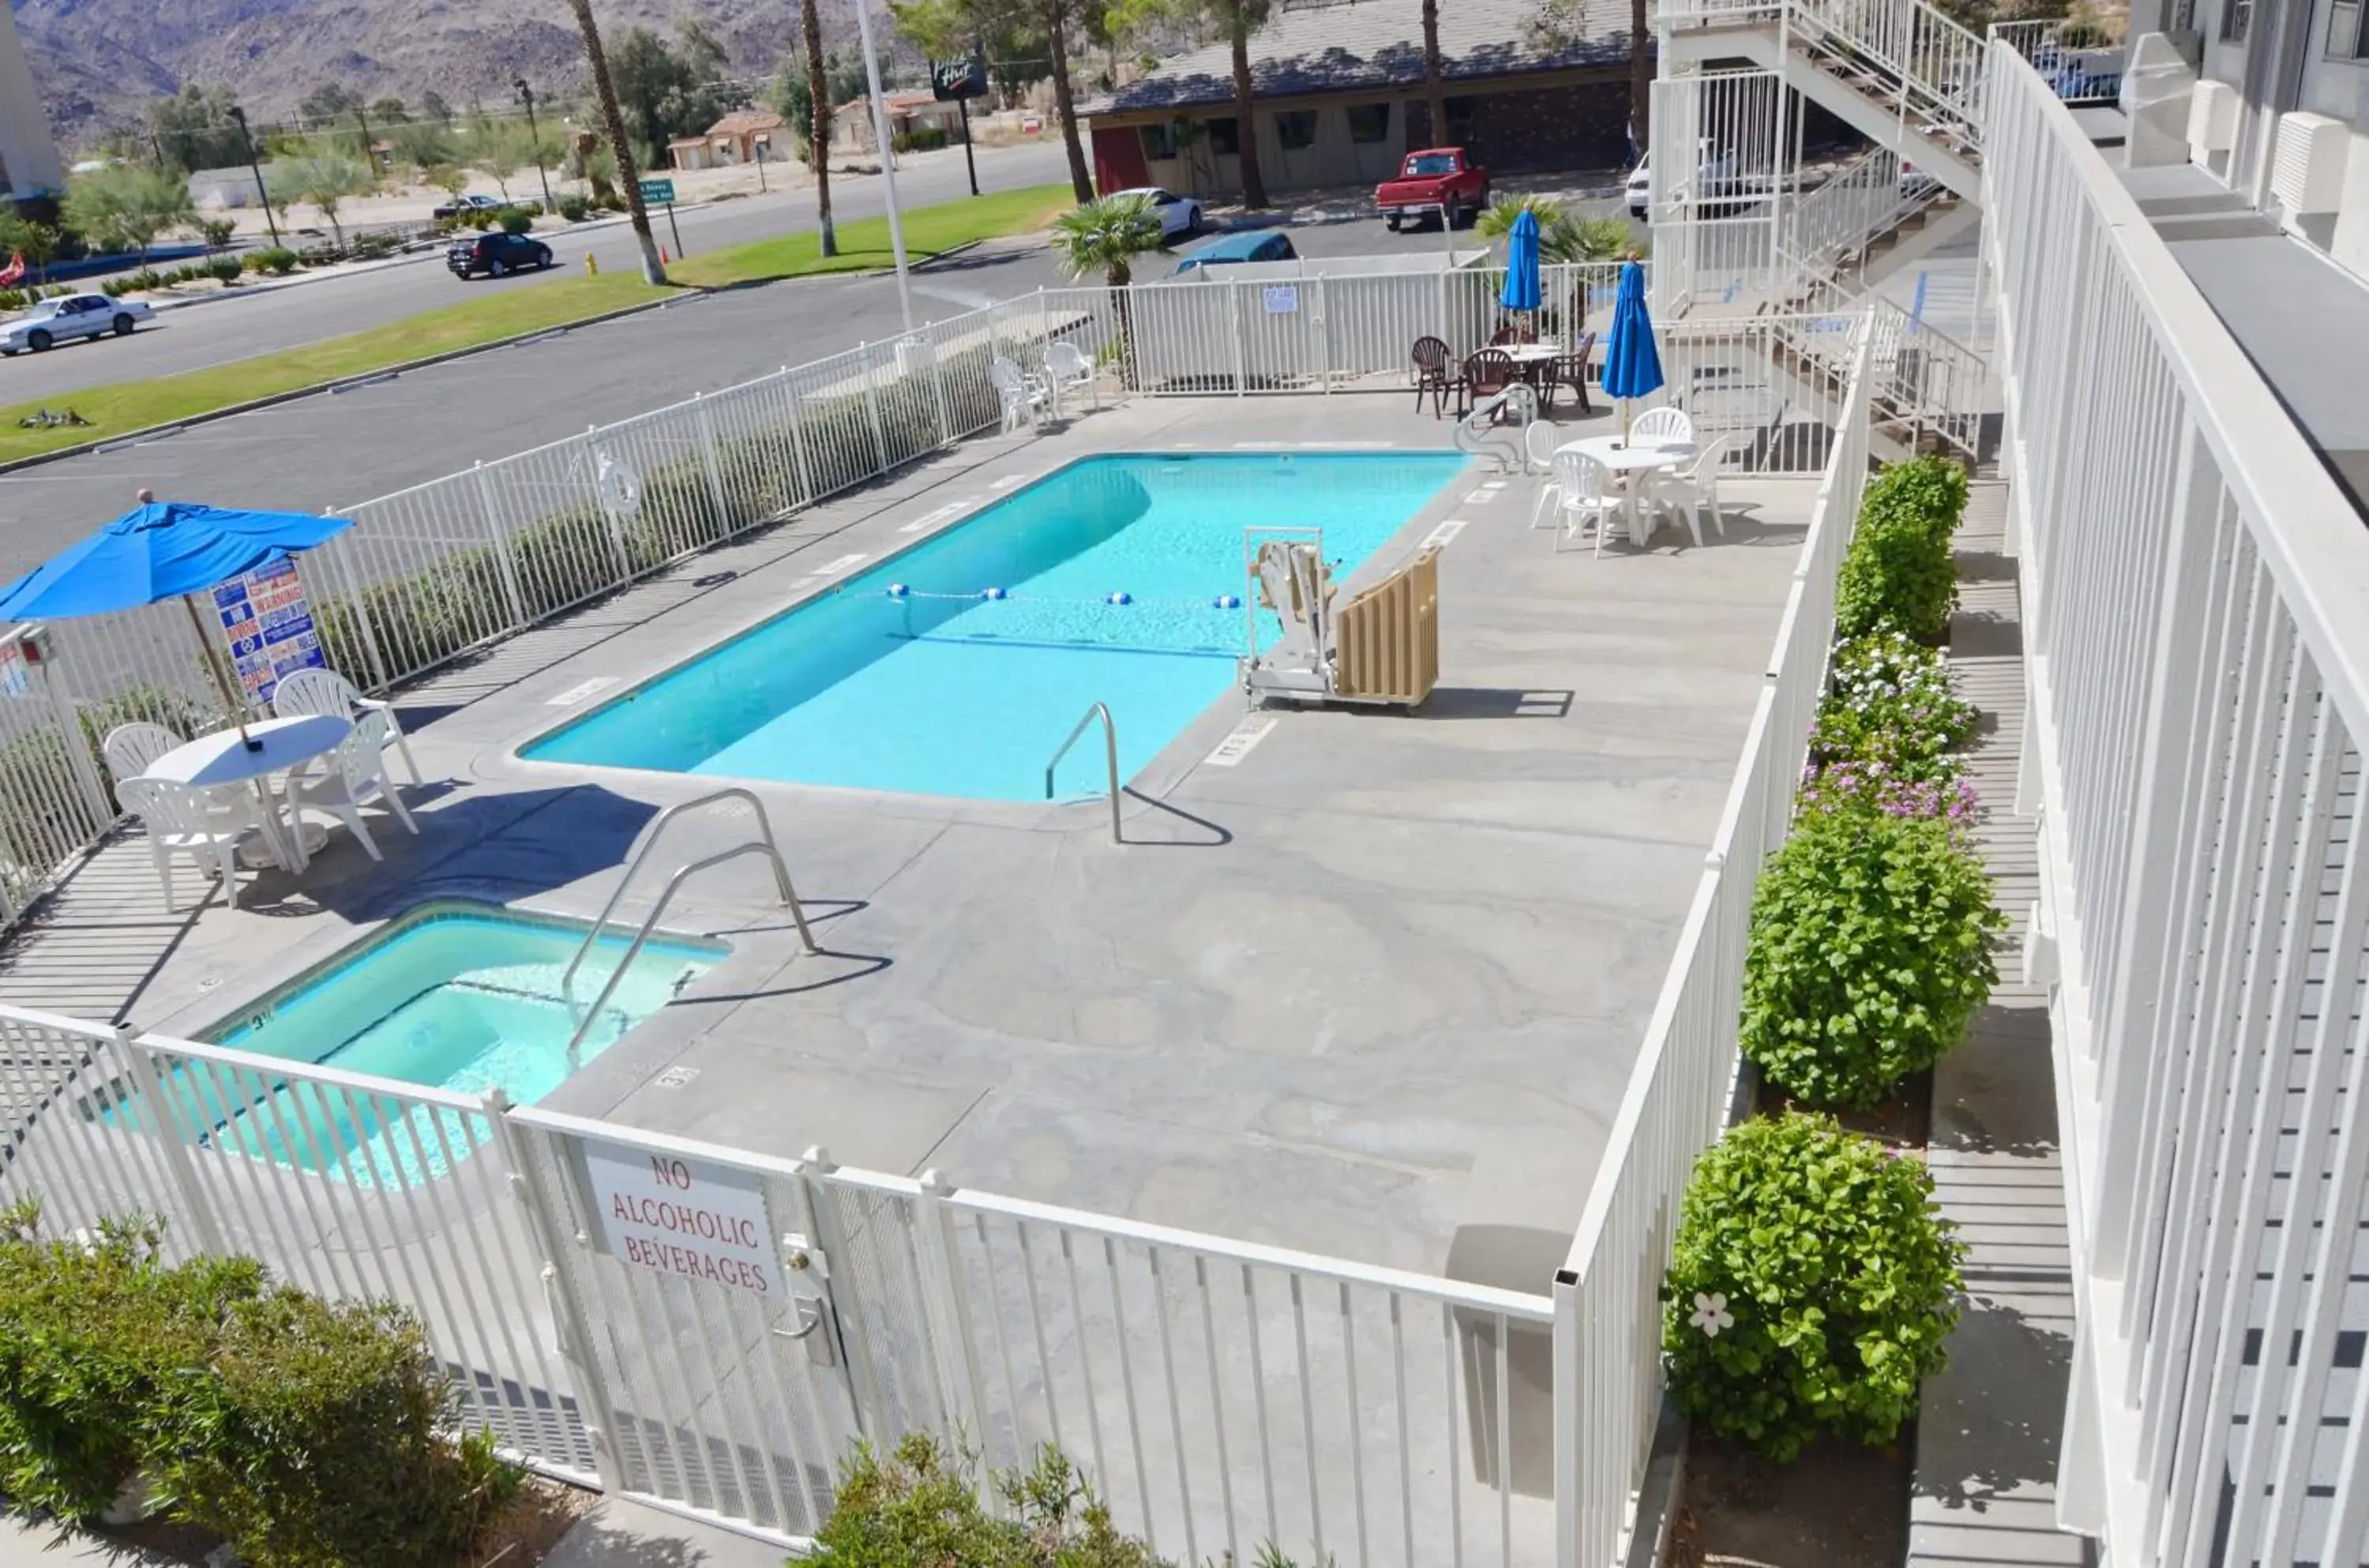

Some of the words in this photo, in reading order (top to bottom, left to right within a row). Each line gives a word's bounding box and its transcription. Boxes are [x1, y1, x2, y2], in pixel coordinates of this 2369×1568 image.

[941, 61, 973, 88] Hut
[651, 1156, 690, 1190] NO
[614, 1192, 759, 1249] ALCOHOLIC
[625, 1236, 768, 1292] BEVERAGES
